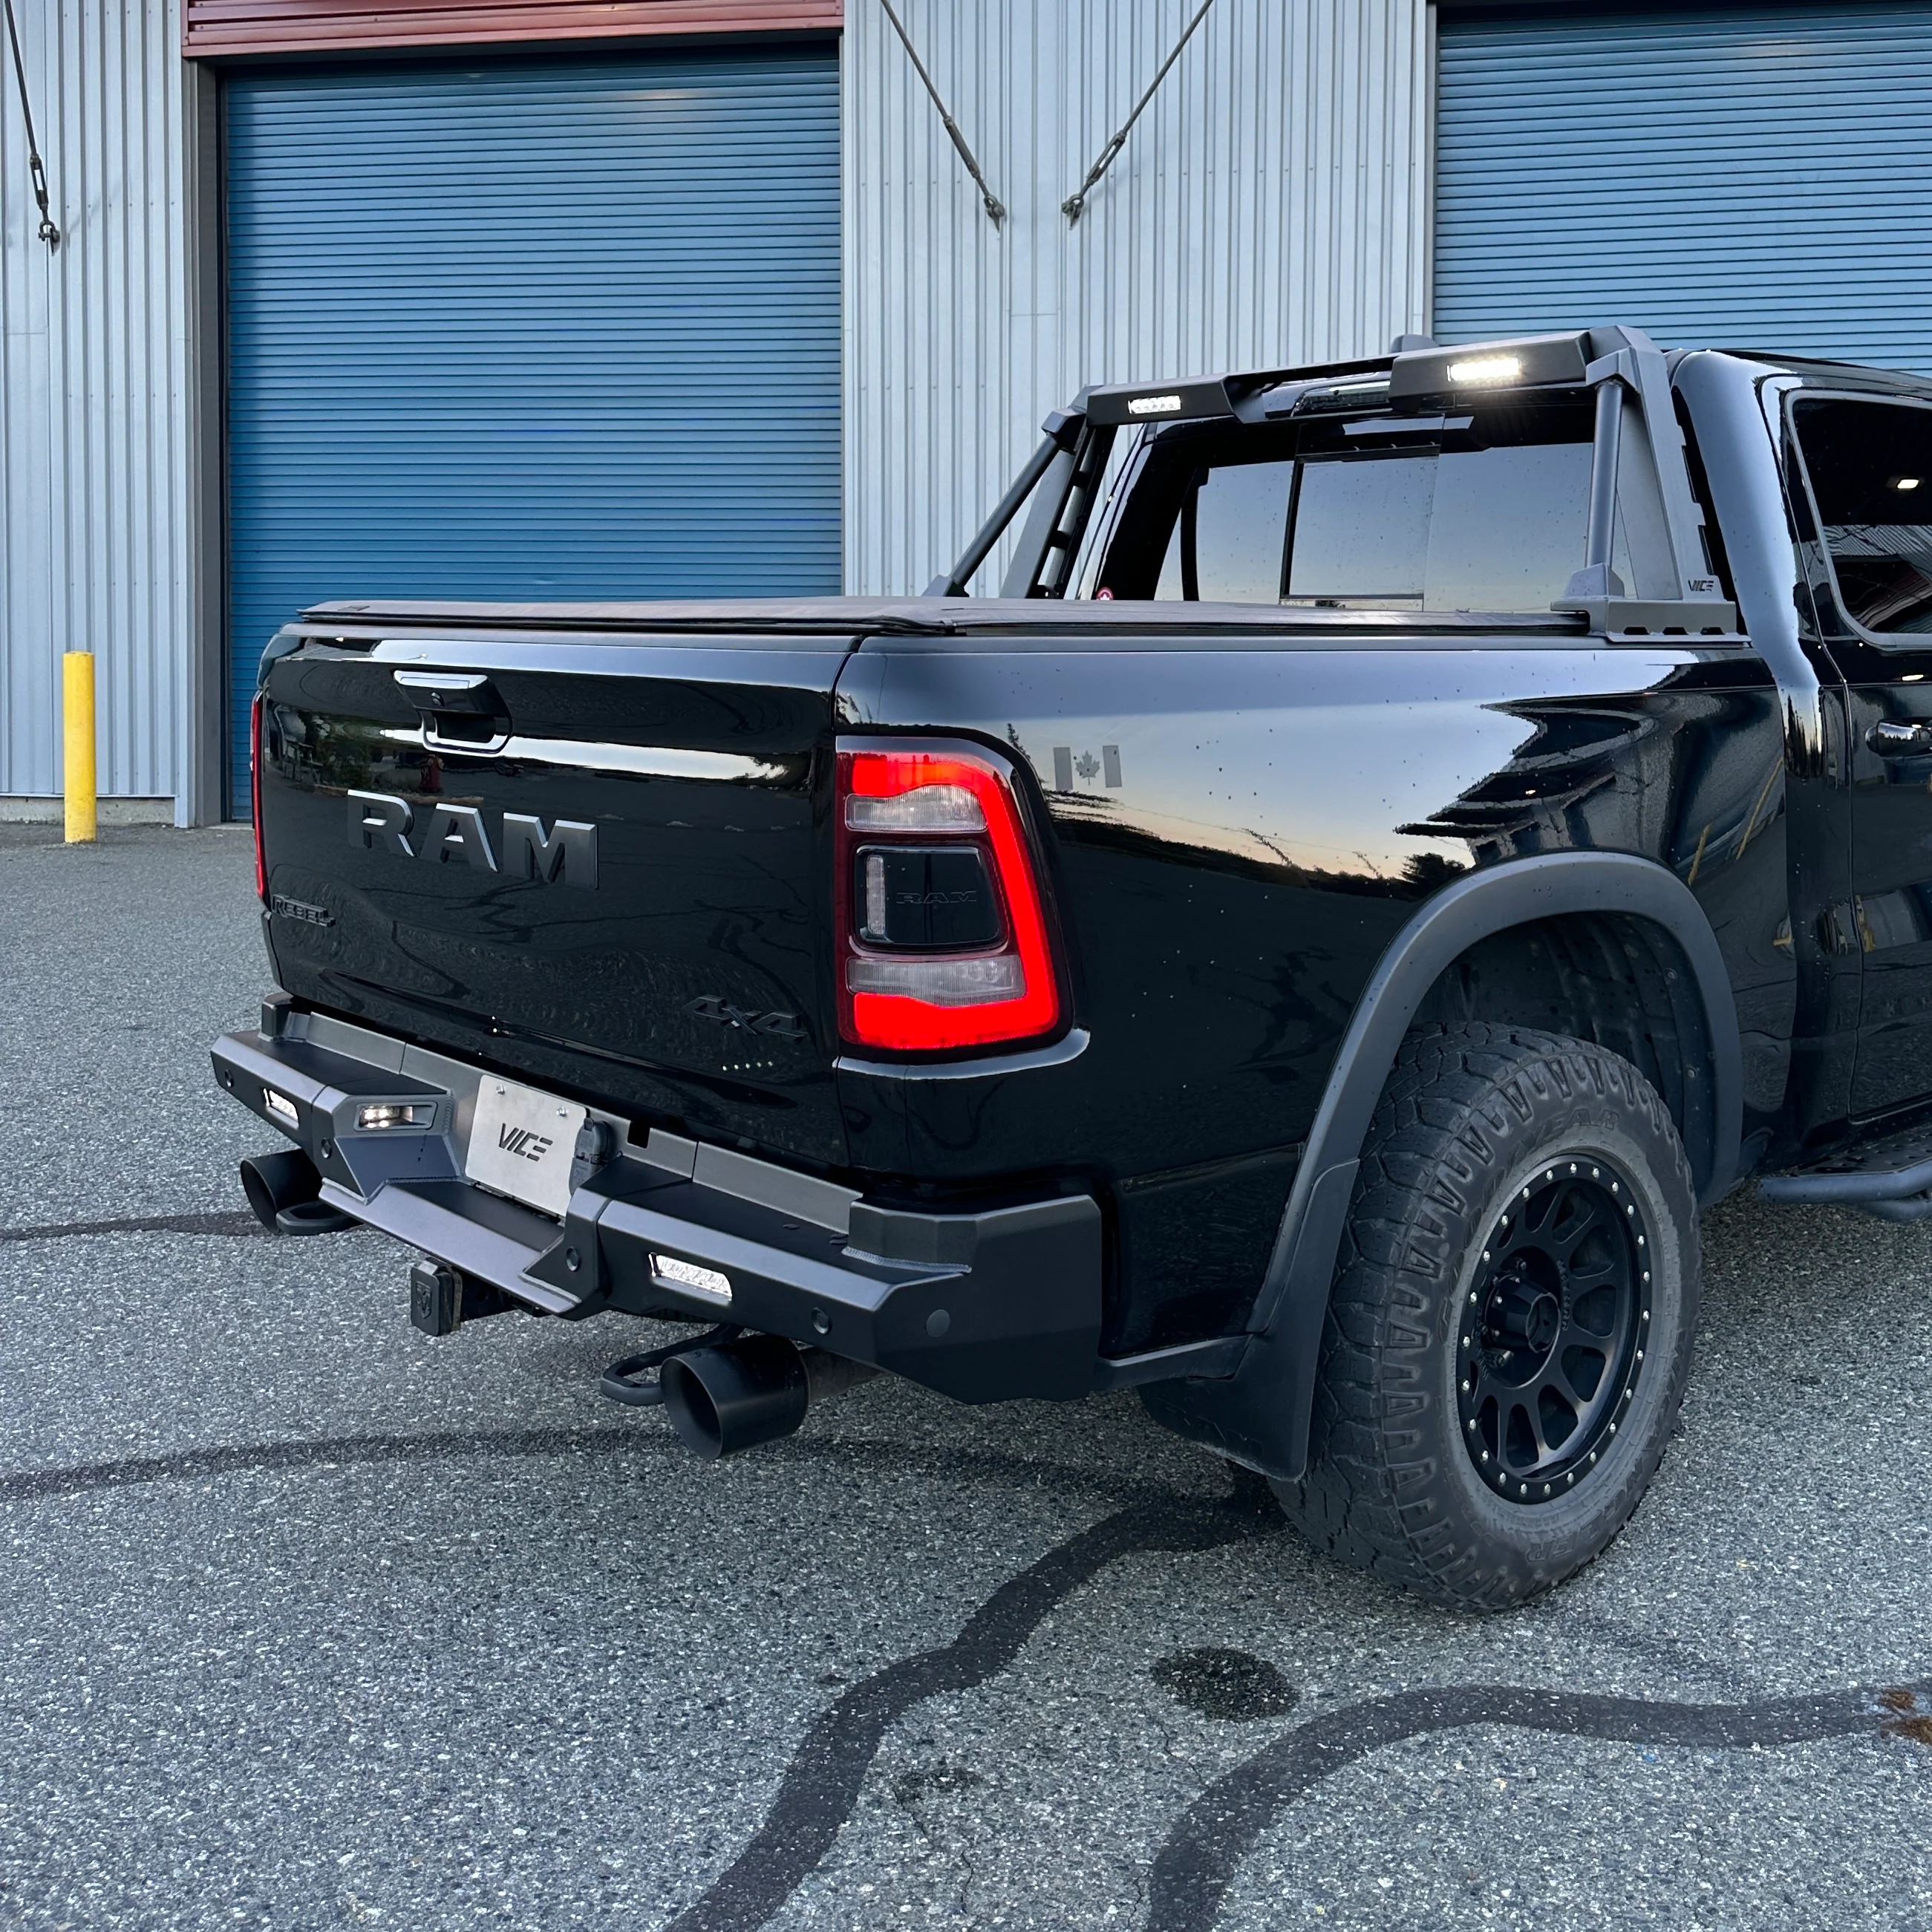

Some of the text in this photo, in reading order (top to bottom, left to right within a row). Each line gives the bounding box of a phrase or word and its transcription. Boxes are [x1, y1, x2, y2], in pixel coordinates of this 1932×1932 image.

[1688, 579, 1714, 592] VICE
[347, 789, 598, 890] RAM
[272, 894, 336, 927] REBEL
[896, 891, 976, 904] RAM
[498, 1123, 554, 1162] VICE
